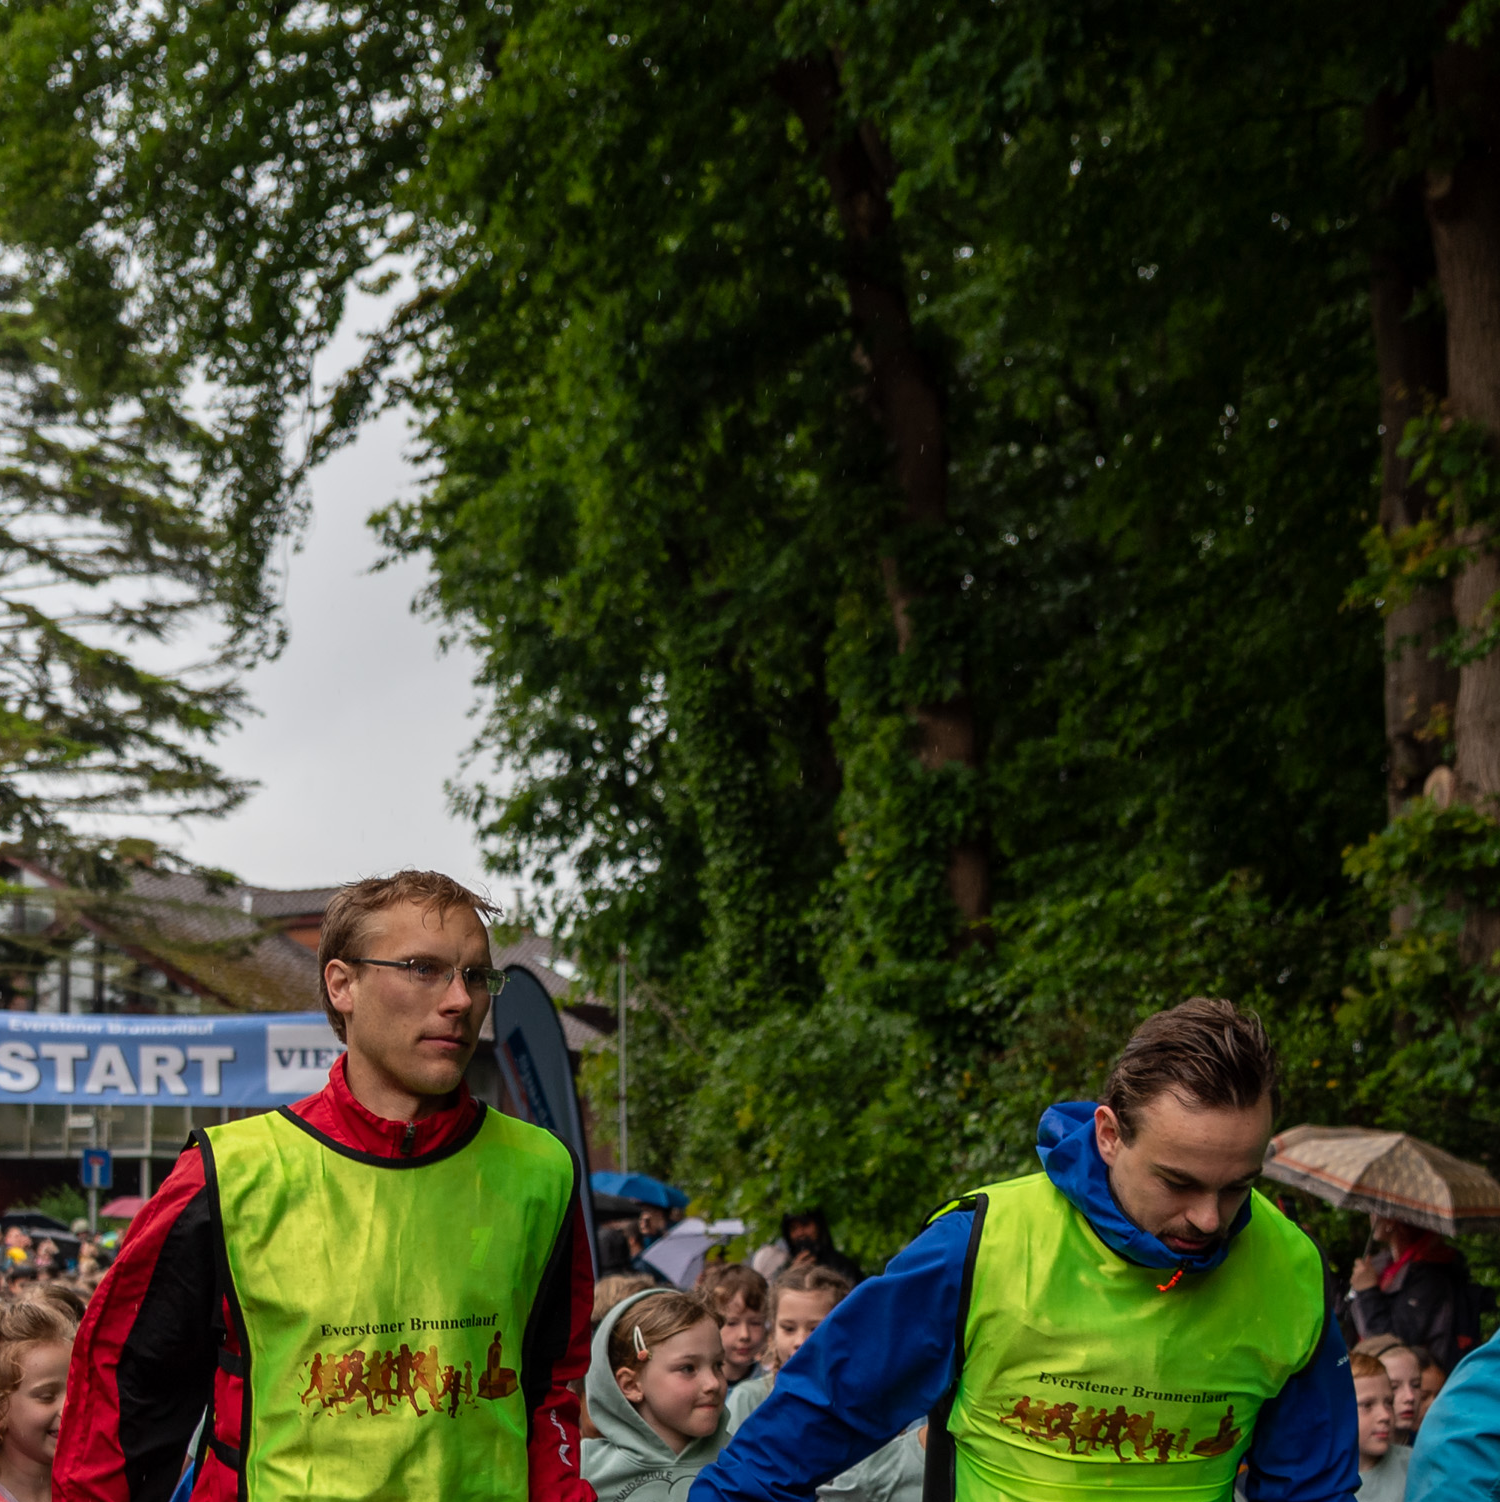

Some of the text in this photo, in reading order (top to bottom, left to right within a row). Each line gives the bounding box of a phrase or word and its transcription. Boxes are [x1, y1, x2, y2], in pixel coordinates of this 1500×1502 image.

[273, 1047, 346, 1069] VIE
[321, 1312, 499, 1338] Everstener Brunnenlauf
[1038, 1371, 1230, 1404] Everstener Brunnenlauf
